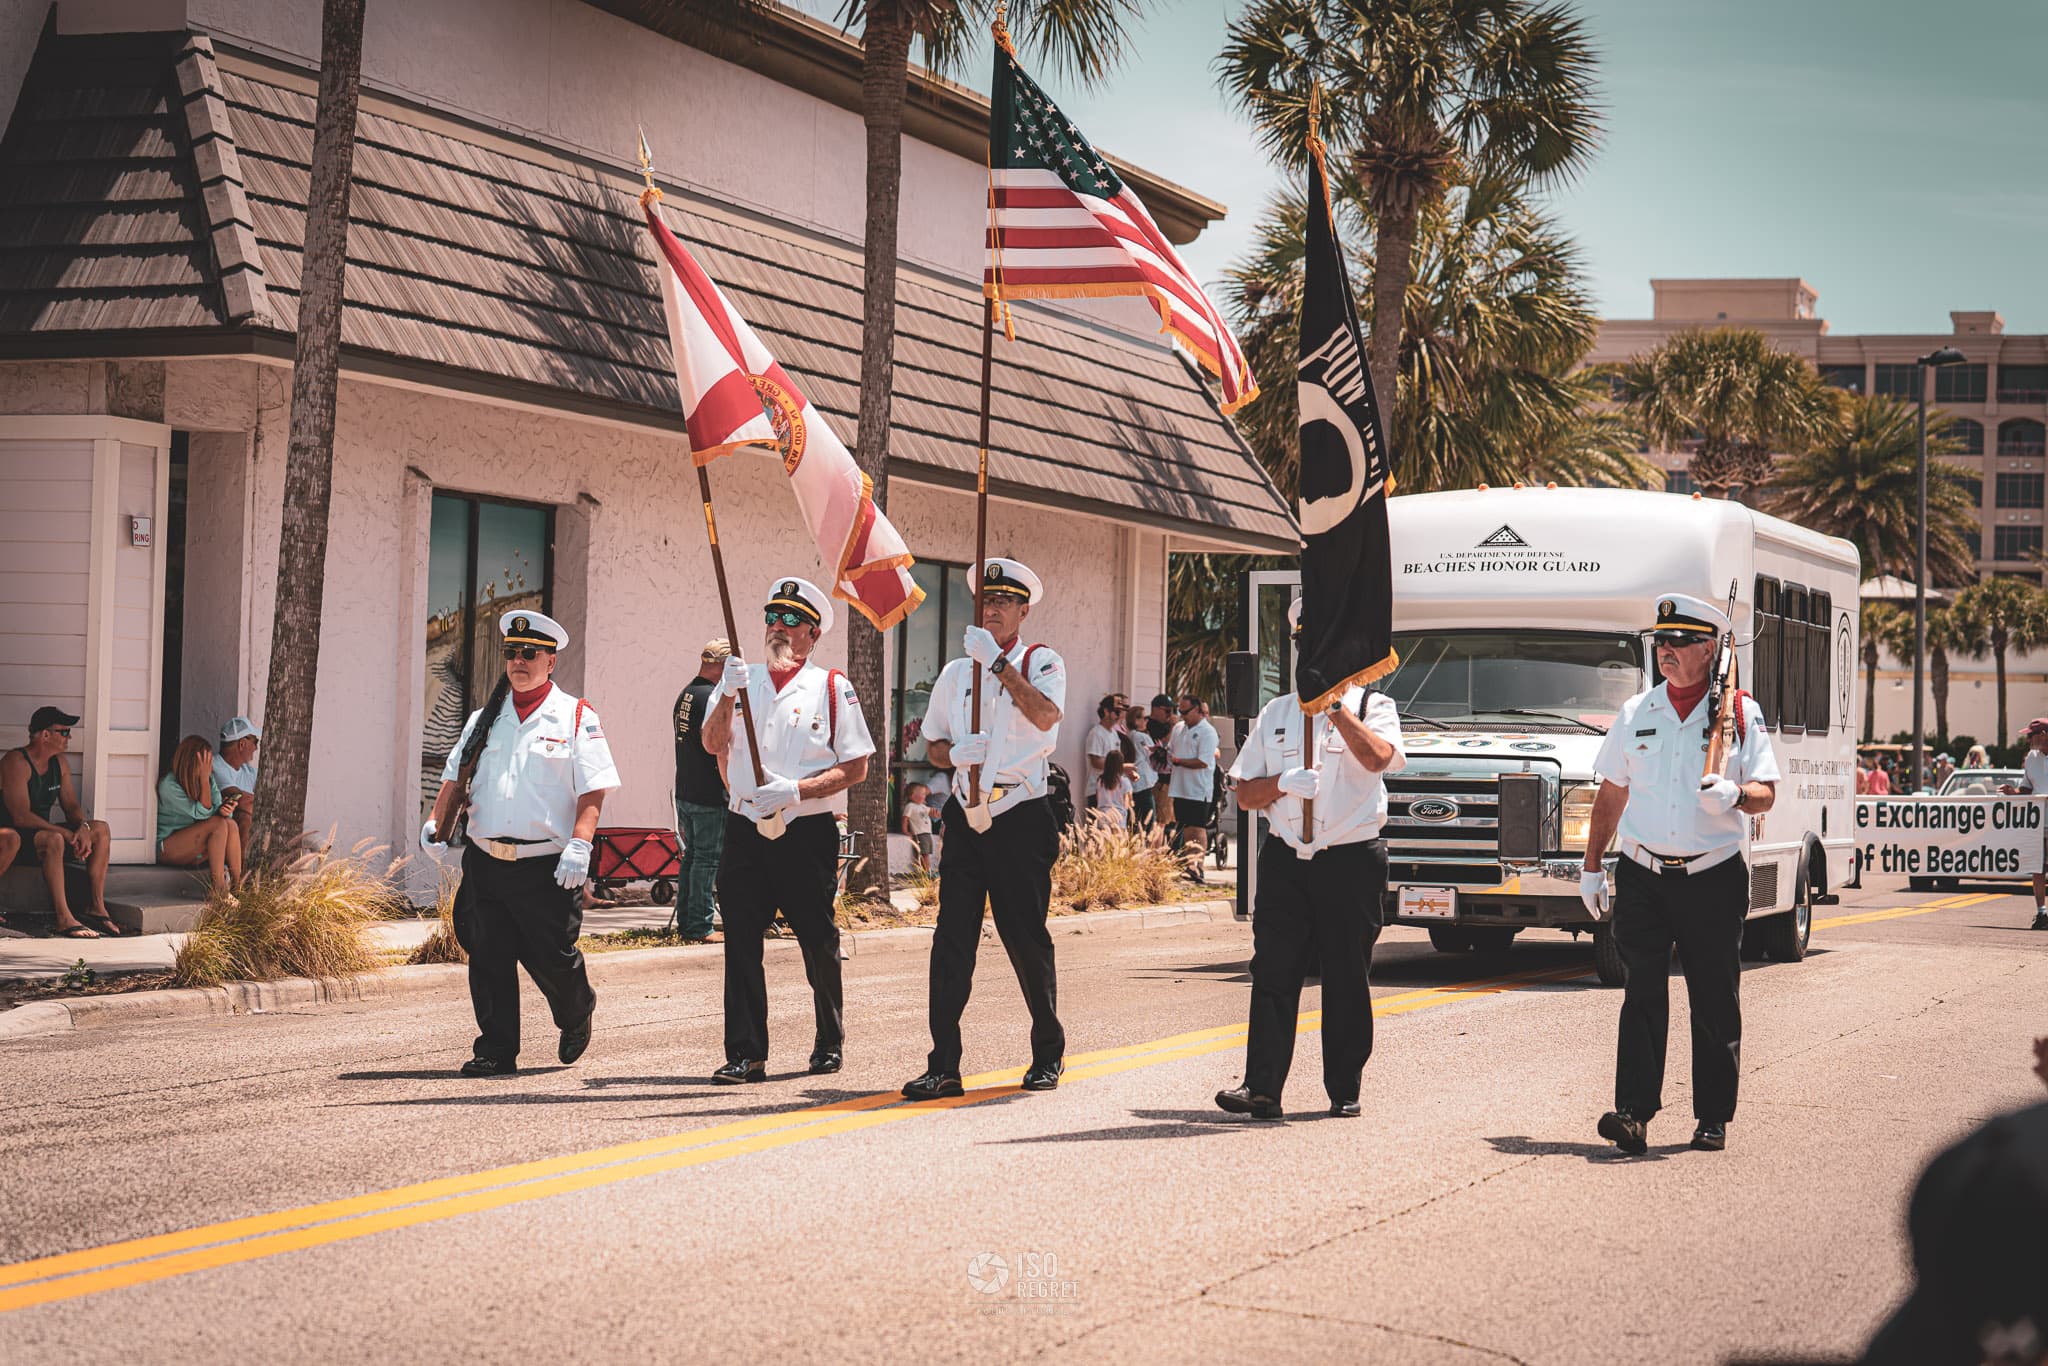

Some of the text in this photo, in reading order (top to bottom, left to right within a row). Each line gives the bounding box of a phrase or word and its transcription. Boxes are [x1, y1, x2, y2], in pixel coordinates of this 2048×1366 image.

[1456, 551, 1513, 559] DEPARTMENT
[1403, 560, 1601, 574] BEACHES HONOR GUARD
[1420, 804, 1444, 815] Ford
[1875, 802, 1986, 834] Exchange
[1991, 801, 2041, 830] Club
[1880, 843, 1921, 873] the
[1926, 845, 2020, 873] Beaches
